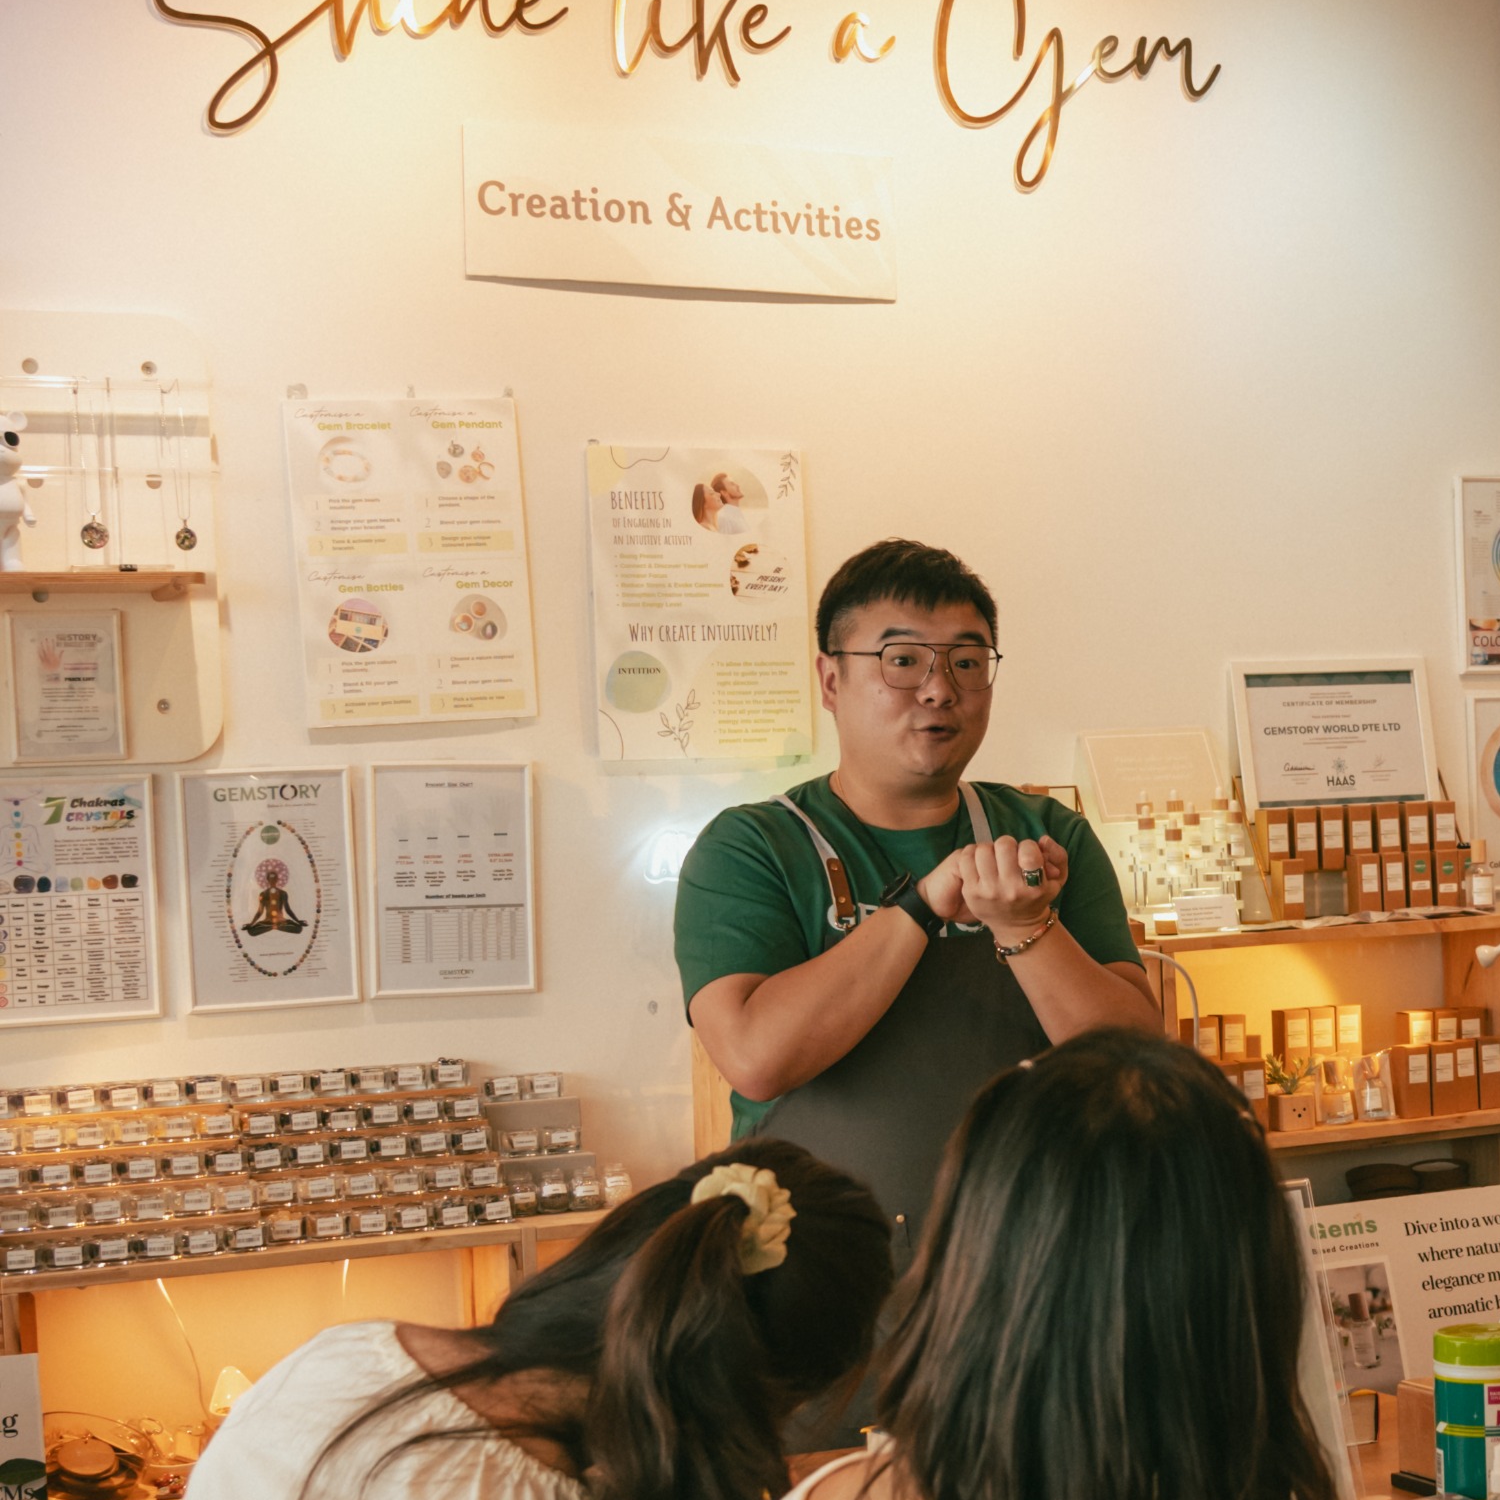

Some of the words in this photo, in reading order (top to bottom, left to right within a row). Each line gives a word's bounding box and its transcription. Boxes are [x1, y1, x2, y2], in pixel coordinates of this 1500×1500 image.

[833, 11, 897, 61] a
[476, 180, 652, 229] Creation
[665, 192, 694, 233] &
[706, 194, 882, 243] Activities
[317, 422, 343, 431] Gem
[345, 421, 391, 430] Bracelet
[431, 420, 456, 429] Gem
[458, 420, 503, 429] Pendant
[610, 491, 665, 511] BENEFITS
[456, 580, 480, 589] Gem
[482, 579, 514, 588] Decor
[756, 575, 786, 583] PRESENT
[338, 584, 364, 593] Gem
[366, 583, 404, 592] Bottles
[745, 583, 768, 592] EVERY
[618, 667, 661, 675] INTUITION
[1282, 700, 1324, 708] CERTIFICATE
[1263, 725, 1320, 736] GEMSTORY
[1322, 724, 1360, 734] WORLD
[1361, 723, 1380, 732] PTE
[1382, 722, 1401, 732] LTD
[1326, 775, 1356, 787] HAAS
[213, 784, 321, 802] GEMSTORY
[44, 797, 67, 825] 7
[70, 797, 126, 809] Chakras
[65, 810, 135, 822] CRYSTALS
[1309, 1219, 1378, 1240] Gems
[1404, 1220, 1438, 1236] Dive
[1440, 1217, 1470, 1232] into
[1471, 1217, 1481, 1227] a
[1339, 1241, 1380, 1251] Creations
[1418, 1245, 1463, 1263] where
[1421, 1271, 1485, 1292] elegance
[1428, 1297, 1493, 1319] aromatic
